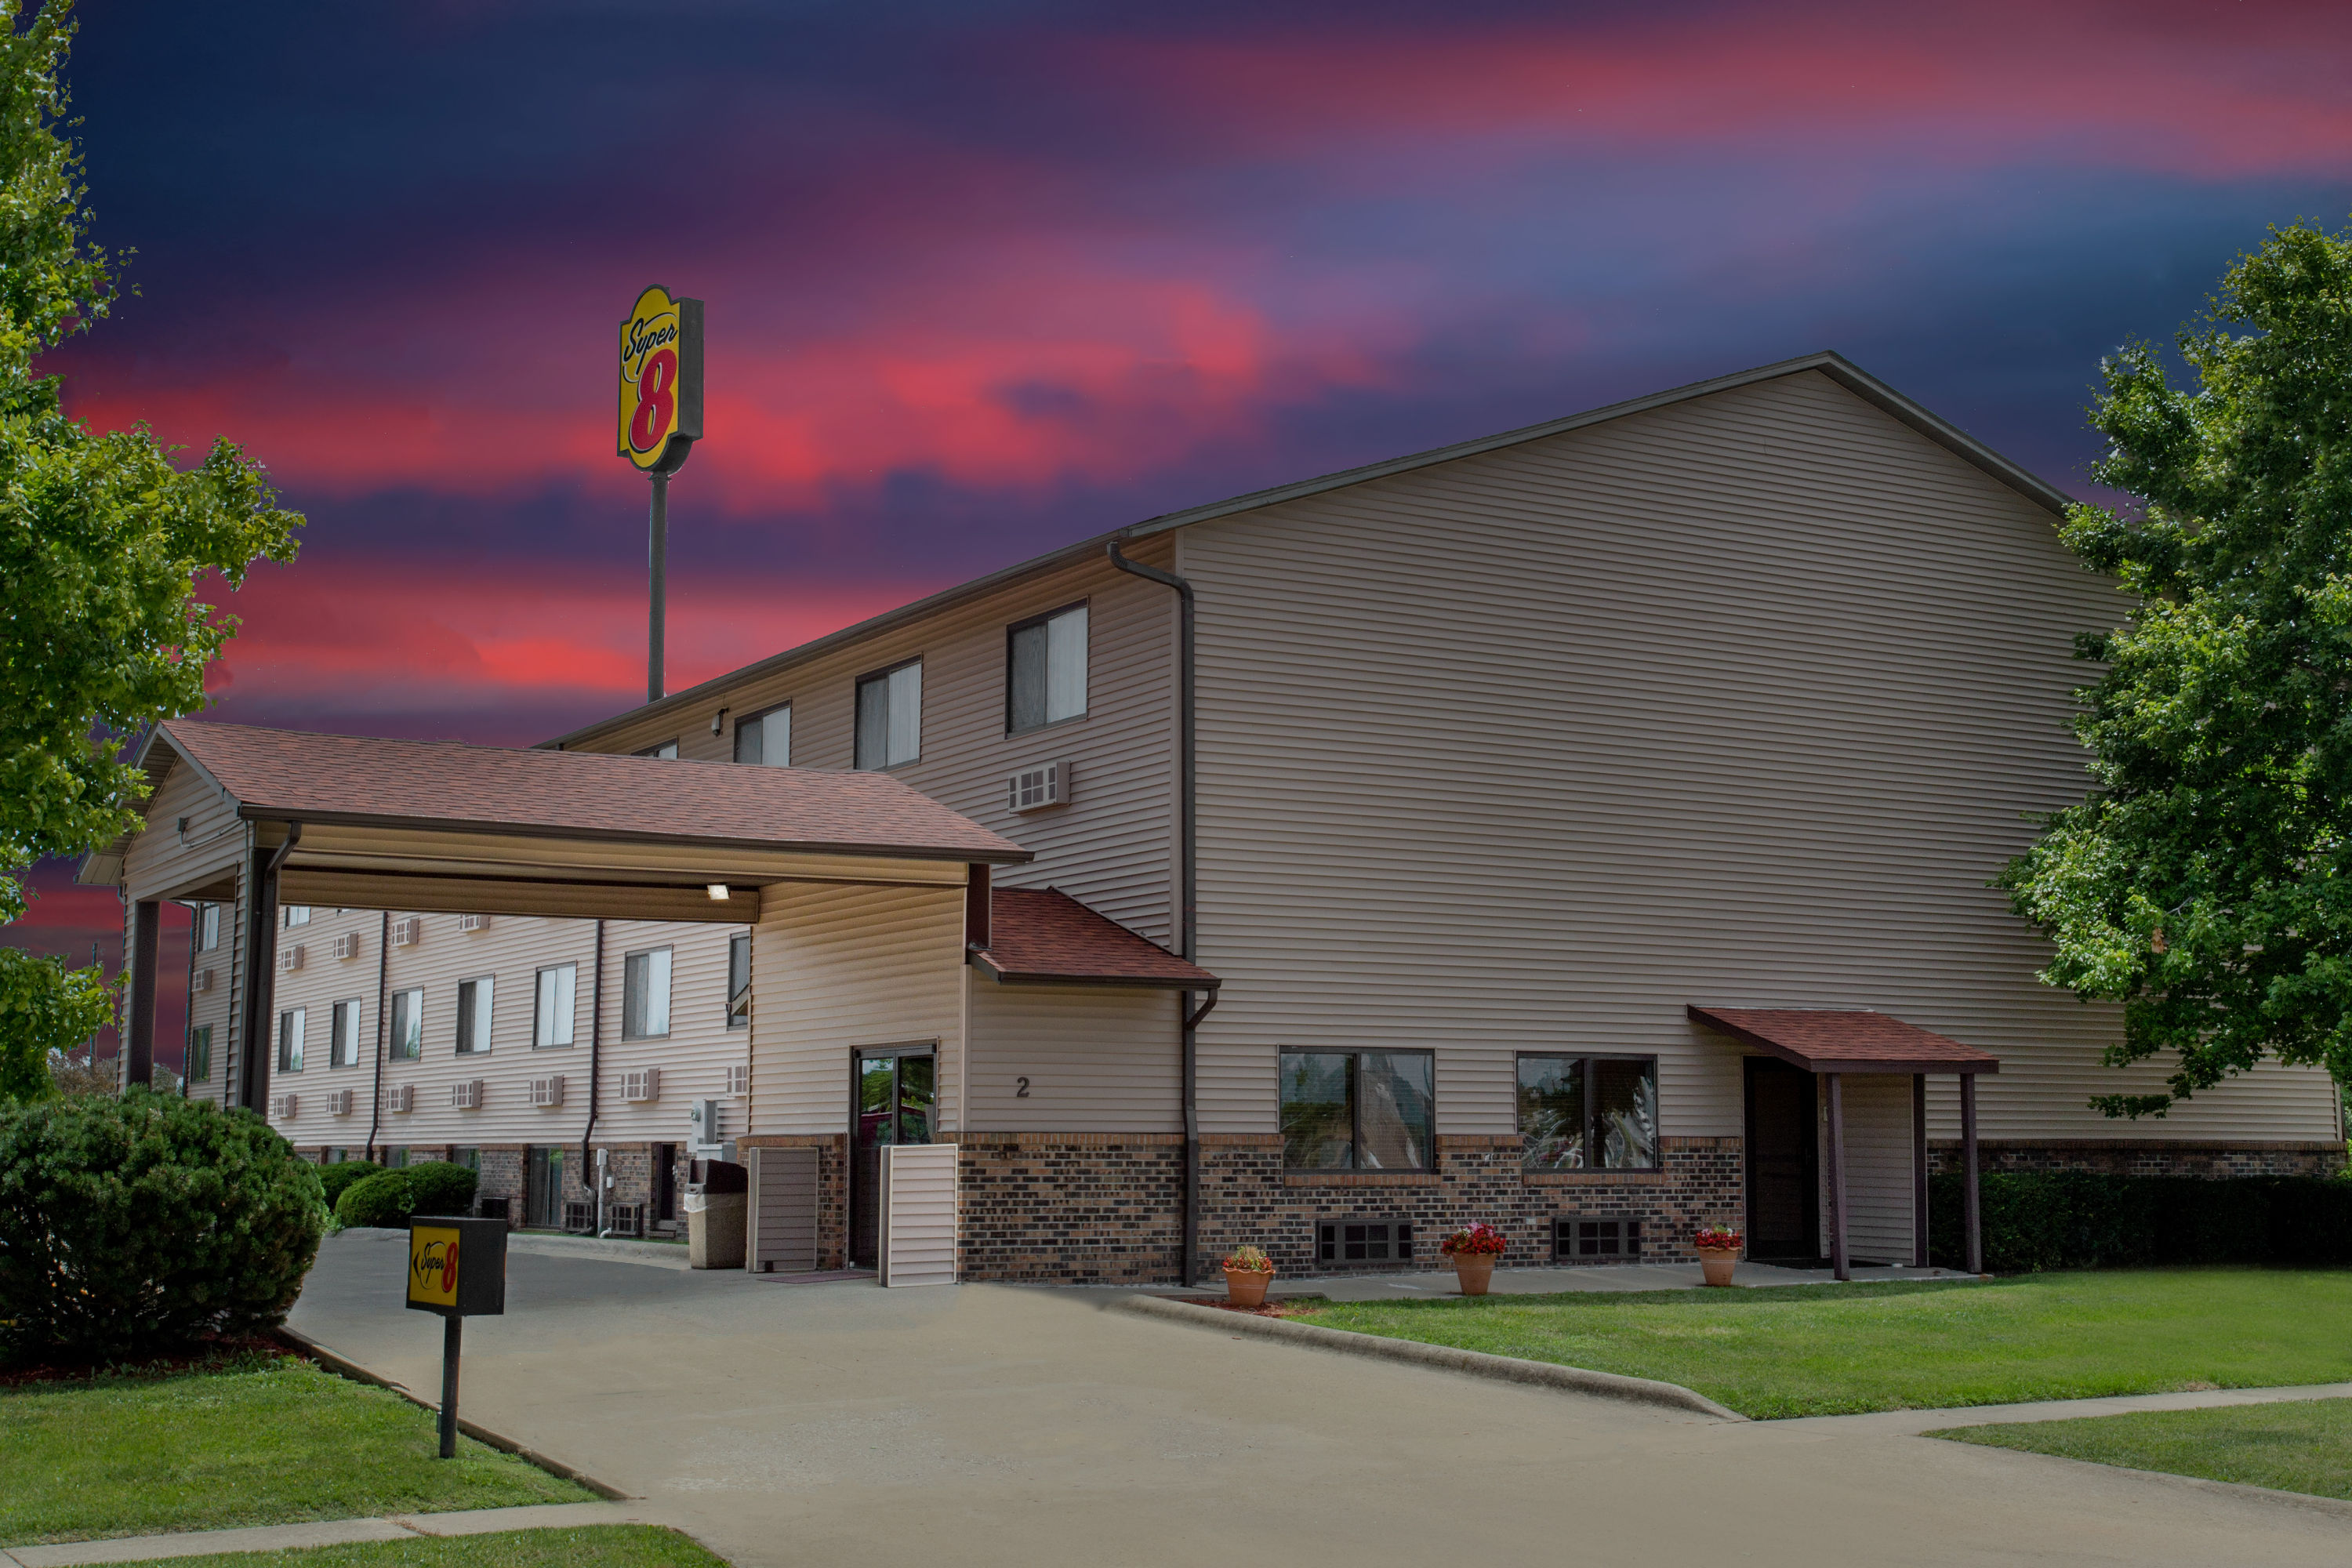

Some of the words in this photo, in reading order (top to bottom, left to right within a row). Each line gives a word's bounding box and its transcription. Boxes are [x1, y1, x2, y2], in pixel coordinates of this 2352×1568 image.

[622, 318, 678, 376] Super
[628, 348, 678, 454] 8
[1016, 1076, 1030, 1098] 2
[420, 1242, 445, 1284] Super
[441, 1241, 459, 1294] 8
